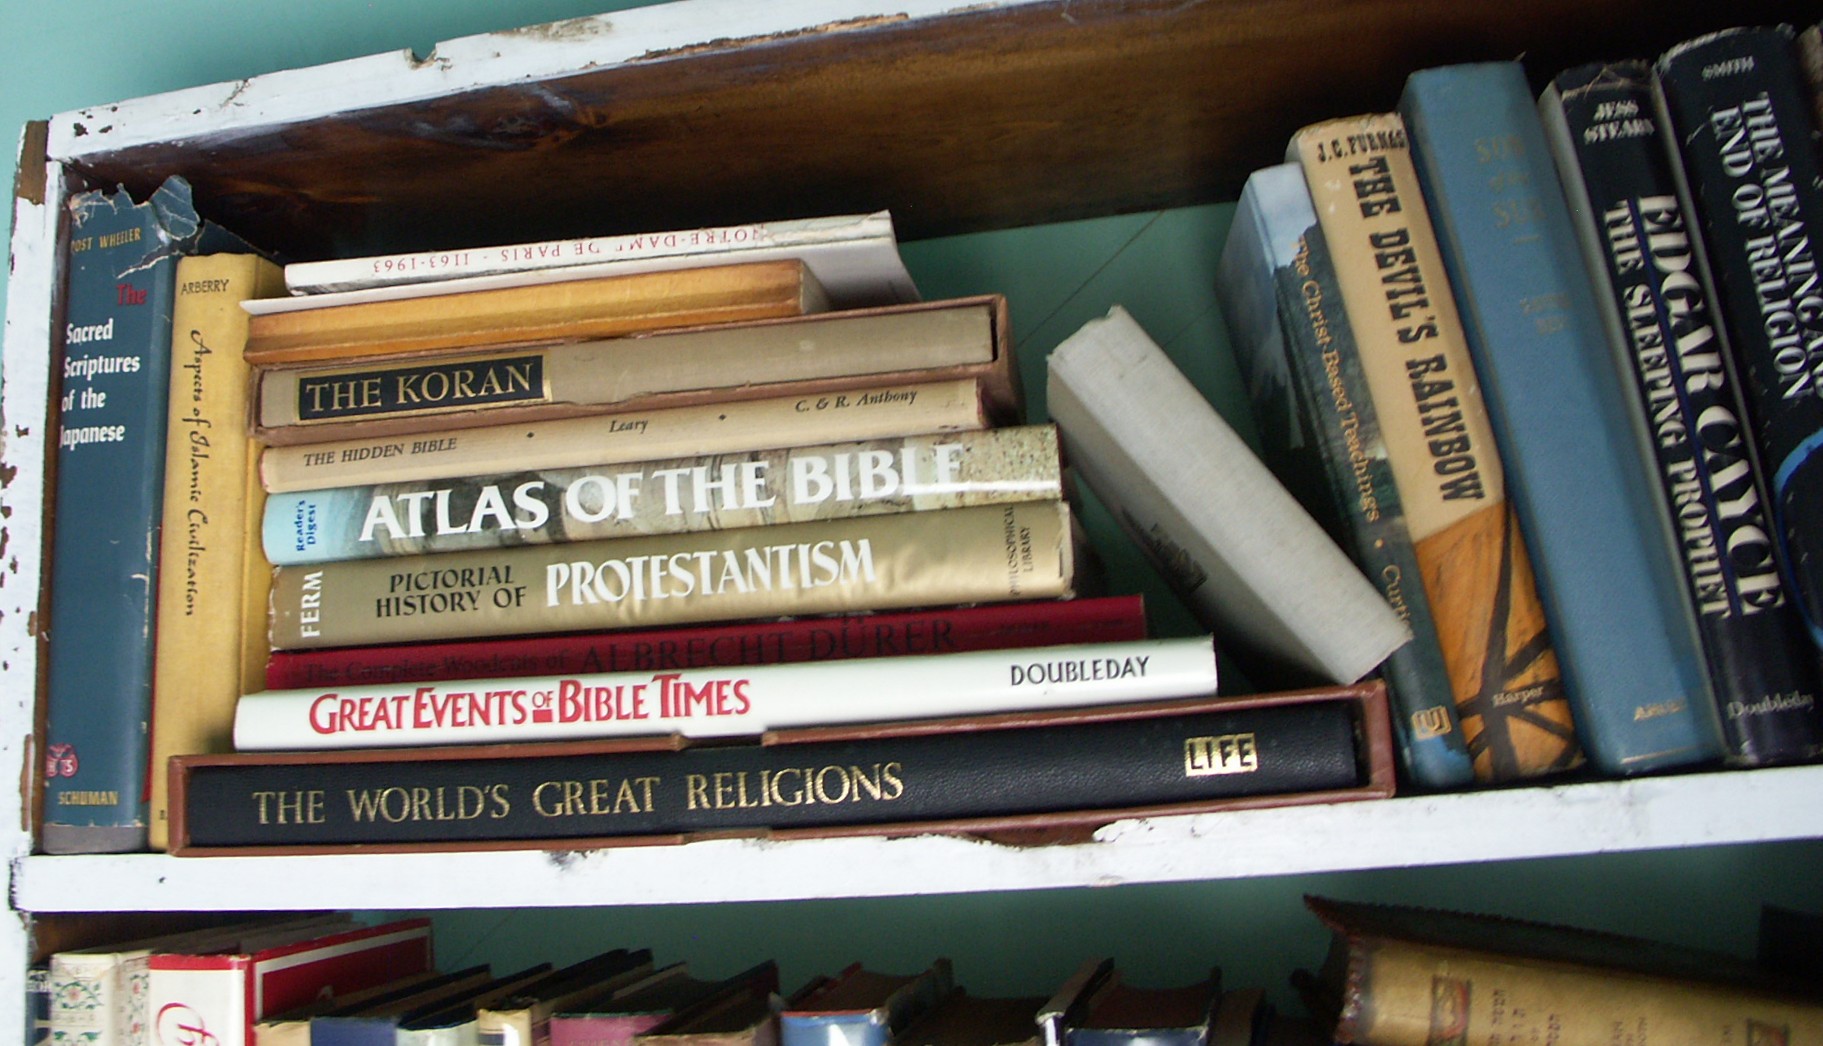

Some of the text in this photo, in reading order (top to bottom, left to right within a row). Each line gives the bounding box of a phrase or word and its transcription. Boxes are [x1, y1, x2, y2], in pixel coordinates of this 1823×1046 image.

[1702, 55, 1755, 81] SMITH
[1741, 91, 1823, 324] THE MEANING
[99, 227, 141, 249] WHEELER
[373, 252, 469, 273] 1163-1963
[501, 244, 561, 263] PARIS
[1711, 105, 1811, 401] END OF RELIGION
[116, 283, 148, 306] The
[181, 278, 230, 296] ARBERRY
[66, 317, 113, 345] Sacred
[1348, 155, 1485, 501] THE DEVIL'S RAINBOW
[63, 354, 141, 381] Scriptures
[305, 362, 535, 413] THE KORAN
[1292, 234, 1311, 277] The
[1303, 279, 1352, 413] Christ-Based
[1341, 411, 1381, 523] Teachings
[61, 386, 106, 412] of the
[1604, 199, 1732, 619] THE SLEEPING PROPHET
[1638, 194, 1785, 617] EDGAR CAYCE
[303, 389, 918, 467] THE HIDDEN BIBLE Leary C. & R. Anthony
[182, 330, 213, 617] Aspects of Islamic Civilization
[358, 443, 964, 542] ATLAS OF THE BIBLE
[294, 499, 307, 552] Reader's
[305, 504, 317, 546] Digest
[1004, 504, 1021, 597] PHILOSOPHICAL
[1020, 526, 1034, 573] LIBRARY
[390, 564, 515, 594] PICTORIAL
[545, 537, 877, 608] PROTESTANTISM
[300, 570, 324, 638] FERM
[376, 586, 528, 618] HISTORY OF
[307, 662, 339, 683] The
[546, 649, 569, 668] of
[580, 631, 797, 675] ALBRECHT
[810, 615, 956, 660] DÜRER
[309, 655, 1150, 735] GREAT EVENTS OF BIBLE TIMES DOUBLEDAY
[1492, 685, 1545, 708] Harper
[58, 790, 119, 806] SCHUMAN
[252, 732, 1258, 825] THE WORLD'S GREAT RELIGIONS LIFE
